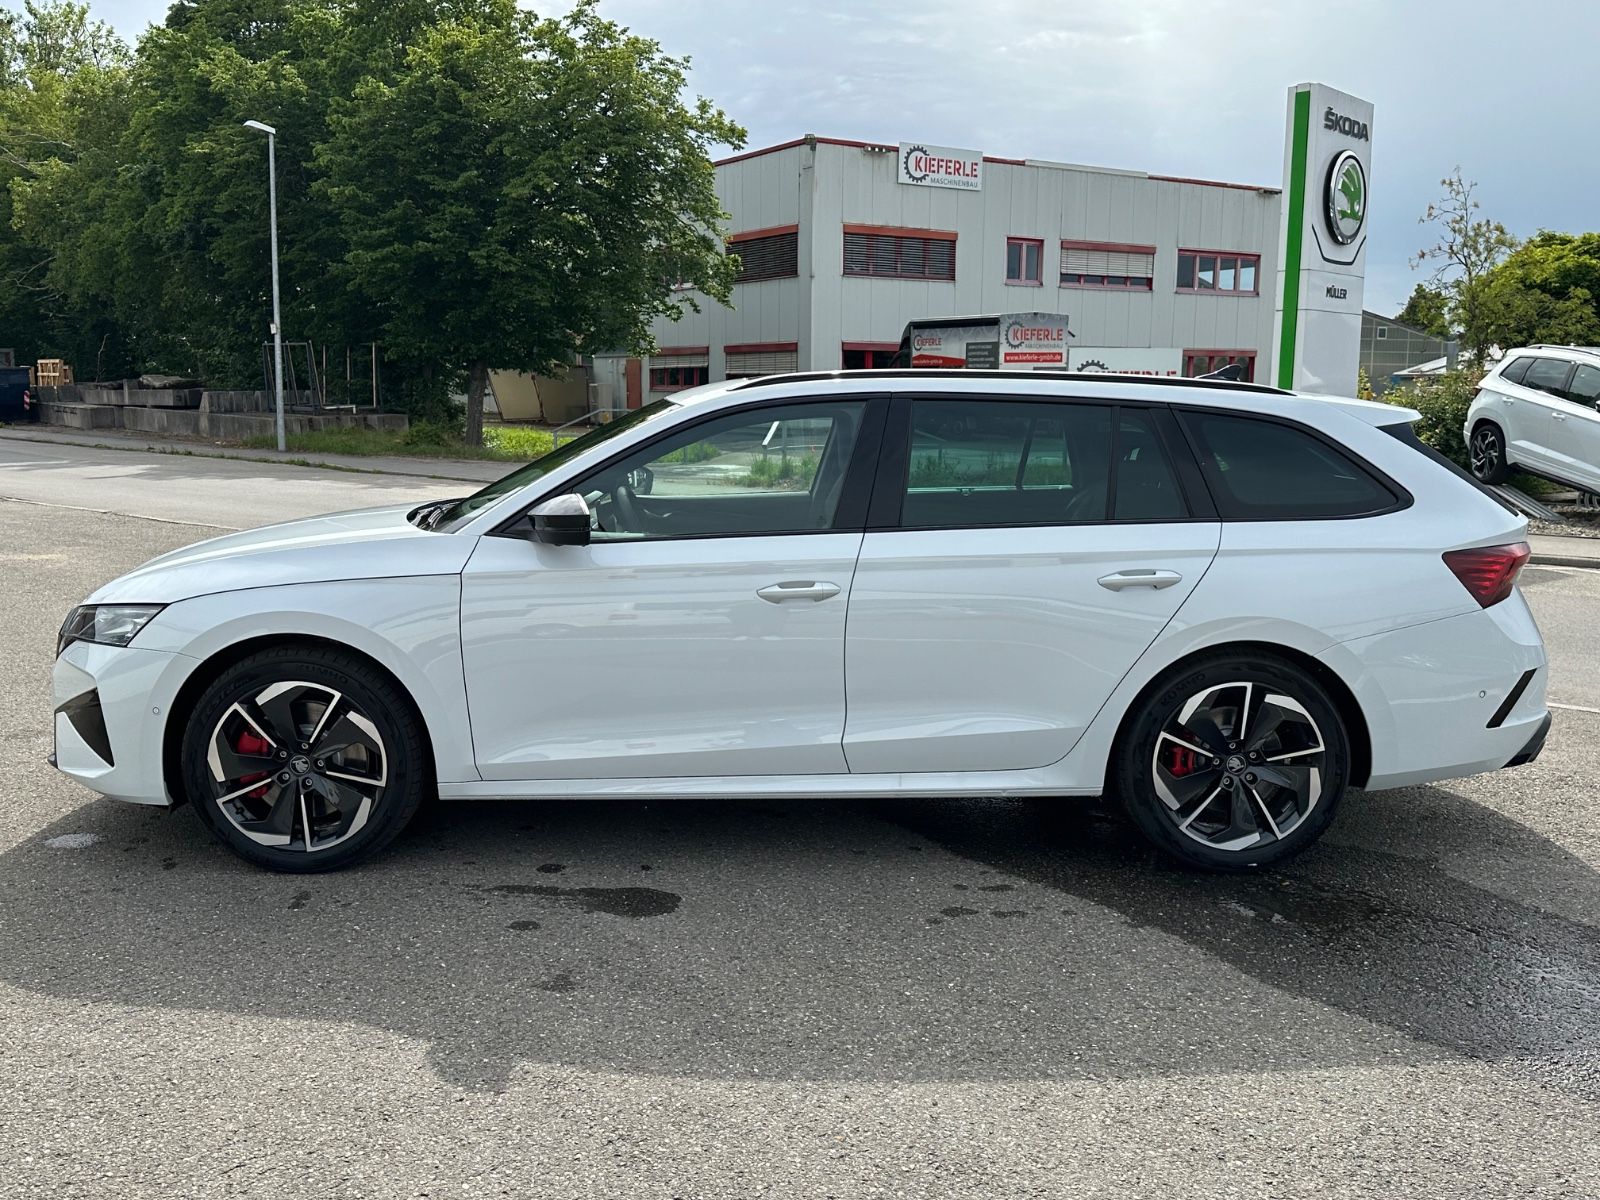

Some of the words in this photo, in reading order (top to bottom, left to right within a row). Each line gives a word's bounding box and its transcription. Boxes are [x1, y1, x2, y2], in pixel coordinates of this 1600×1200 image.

[1324, 106, 1369, 142] ŠKODA
[914, 155, 979, 178] KIEFERLE
[930, 177, 978, 188] MASCHINENBAU
[1325, 284, 1348, 300] MÜLLER
[1012, 328, 1064, 341] KIEFERLE
[1006, 354, 1061, 362] www.kieferle-gmbh.de
